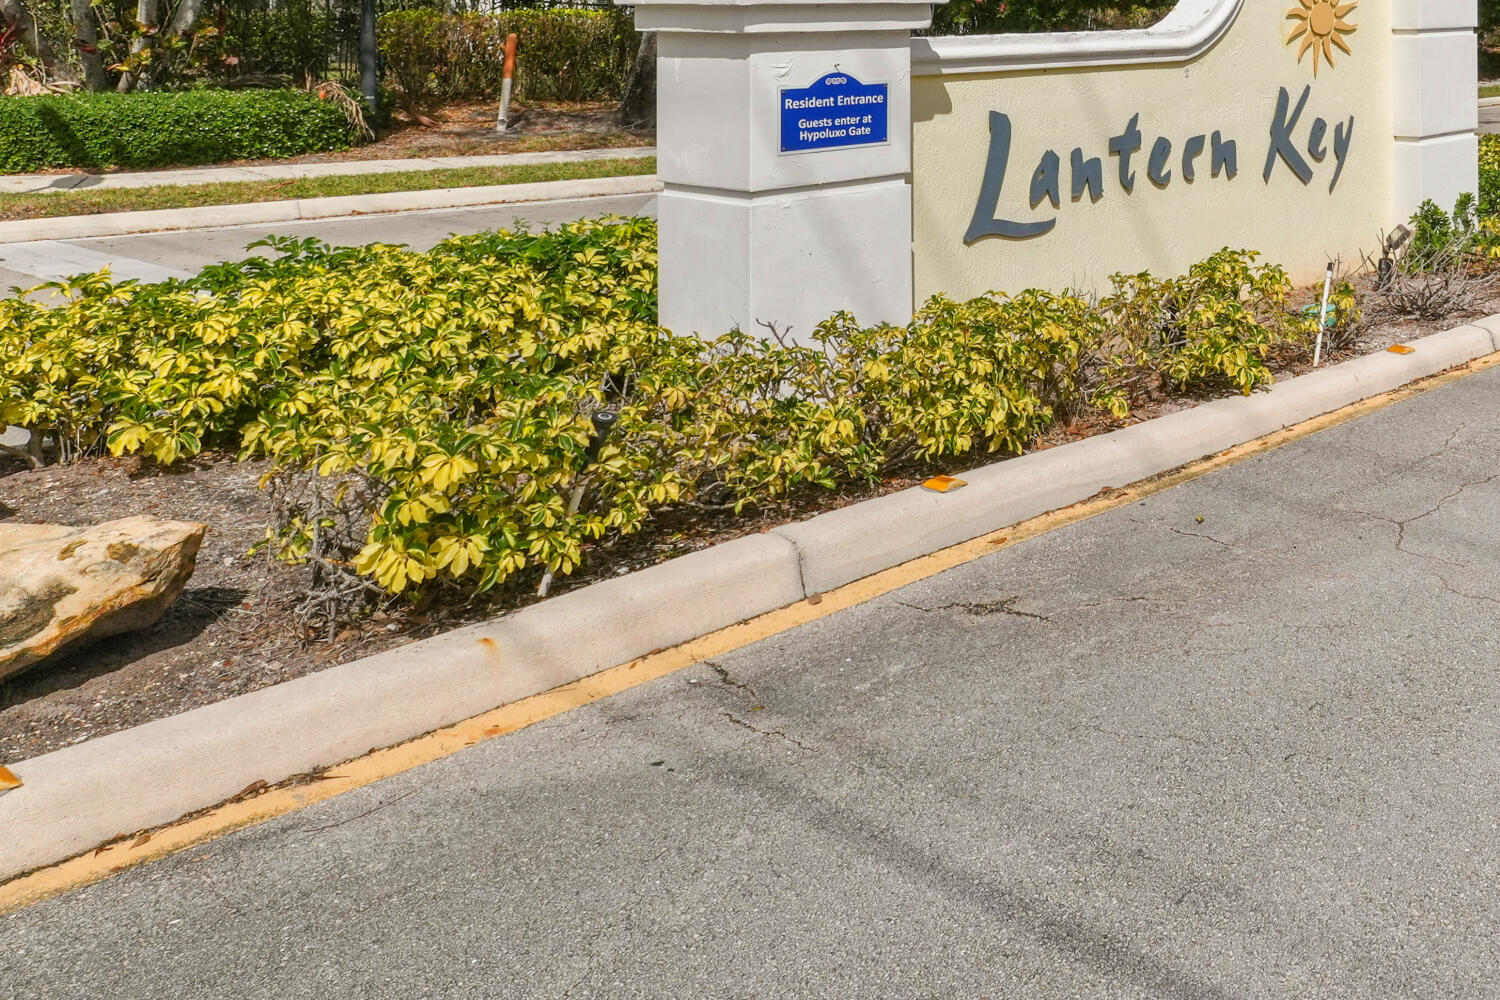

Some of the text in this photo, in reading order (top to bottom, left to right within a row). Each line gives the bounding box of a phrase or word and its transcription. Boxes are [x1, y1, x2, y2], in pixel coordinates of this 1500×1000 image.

[785, 94, 884, 109] Resident Entrance
[798, 114, 872, 128] Guests enter at
[800, 126, 870, 142] Hypoluxo Gate
[963, 84, 1354, 246] Lantern Key
